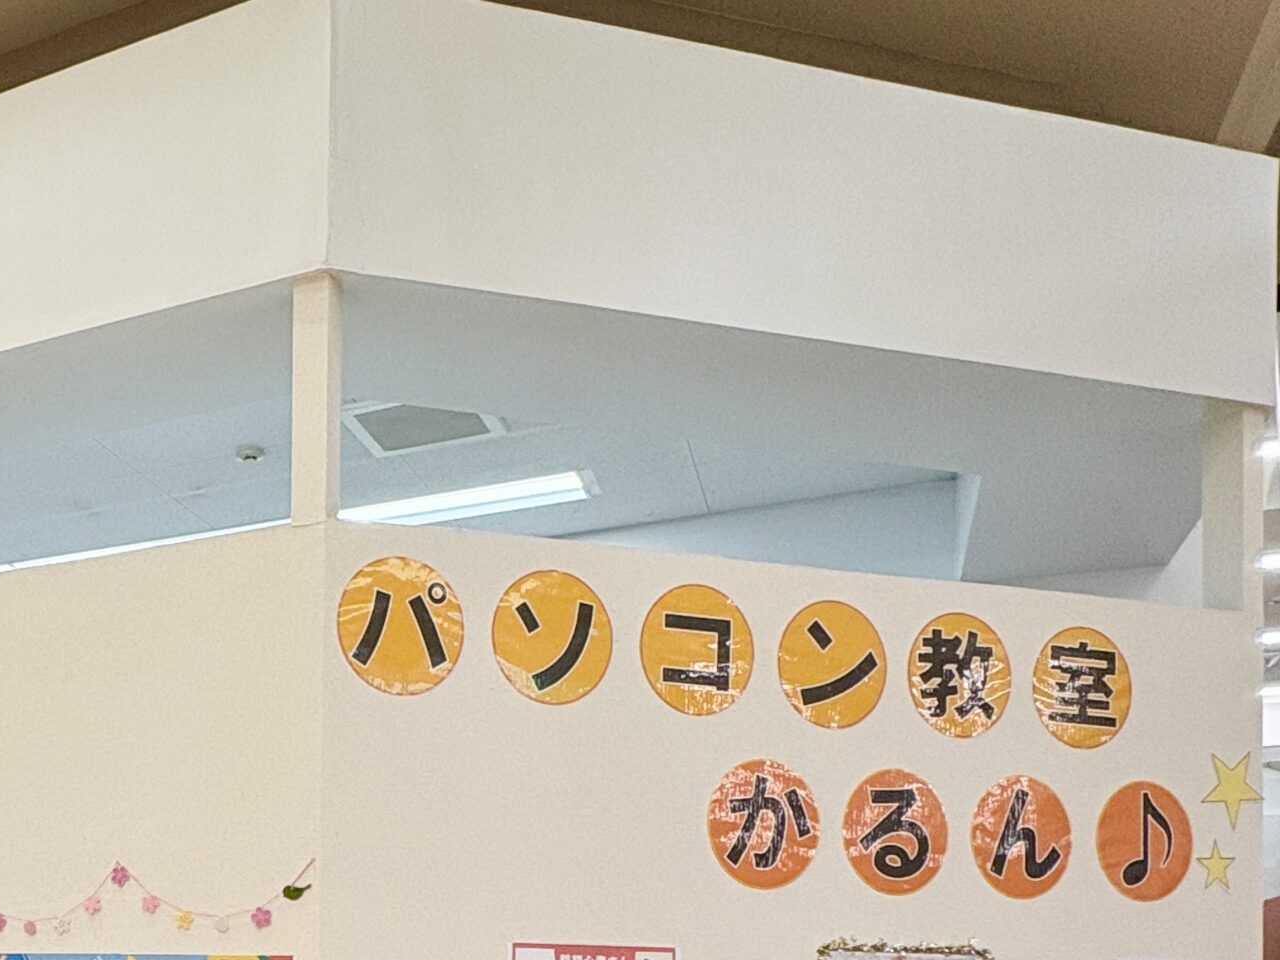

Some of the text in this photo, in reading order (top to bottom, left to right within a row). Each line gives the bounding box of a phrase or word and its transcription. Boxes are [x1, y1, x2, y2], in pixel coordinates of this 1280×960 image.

[349, 581, 1118, 730] パソコン教室
